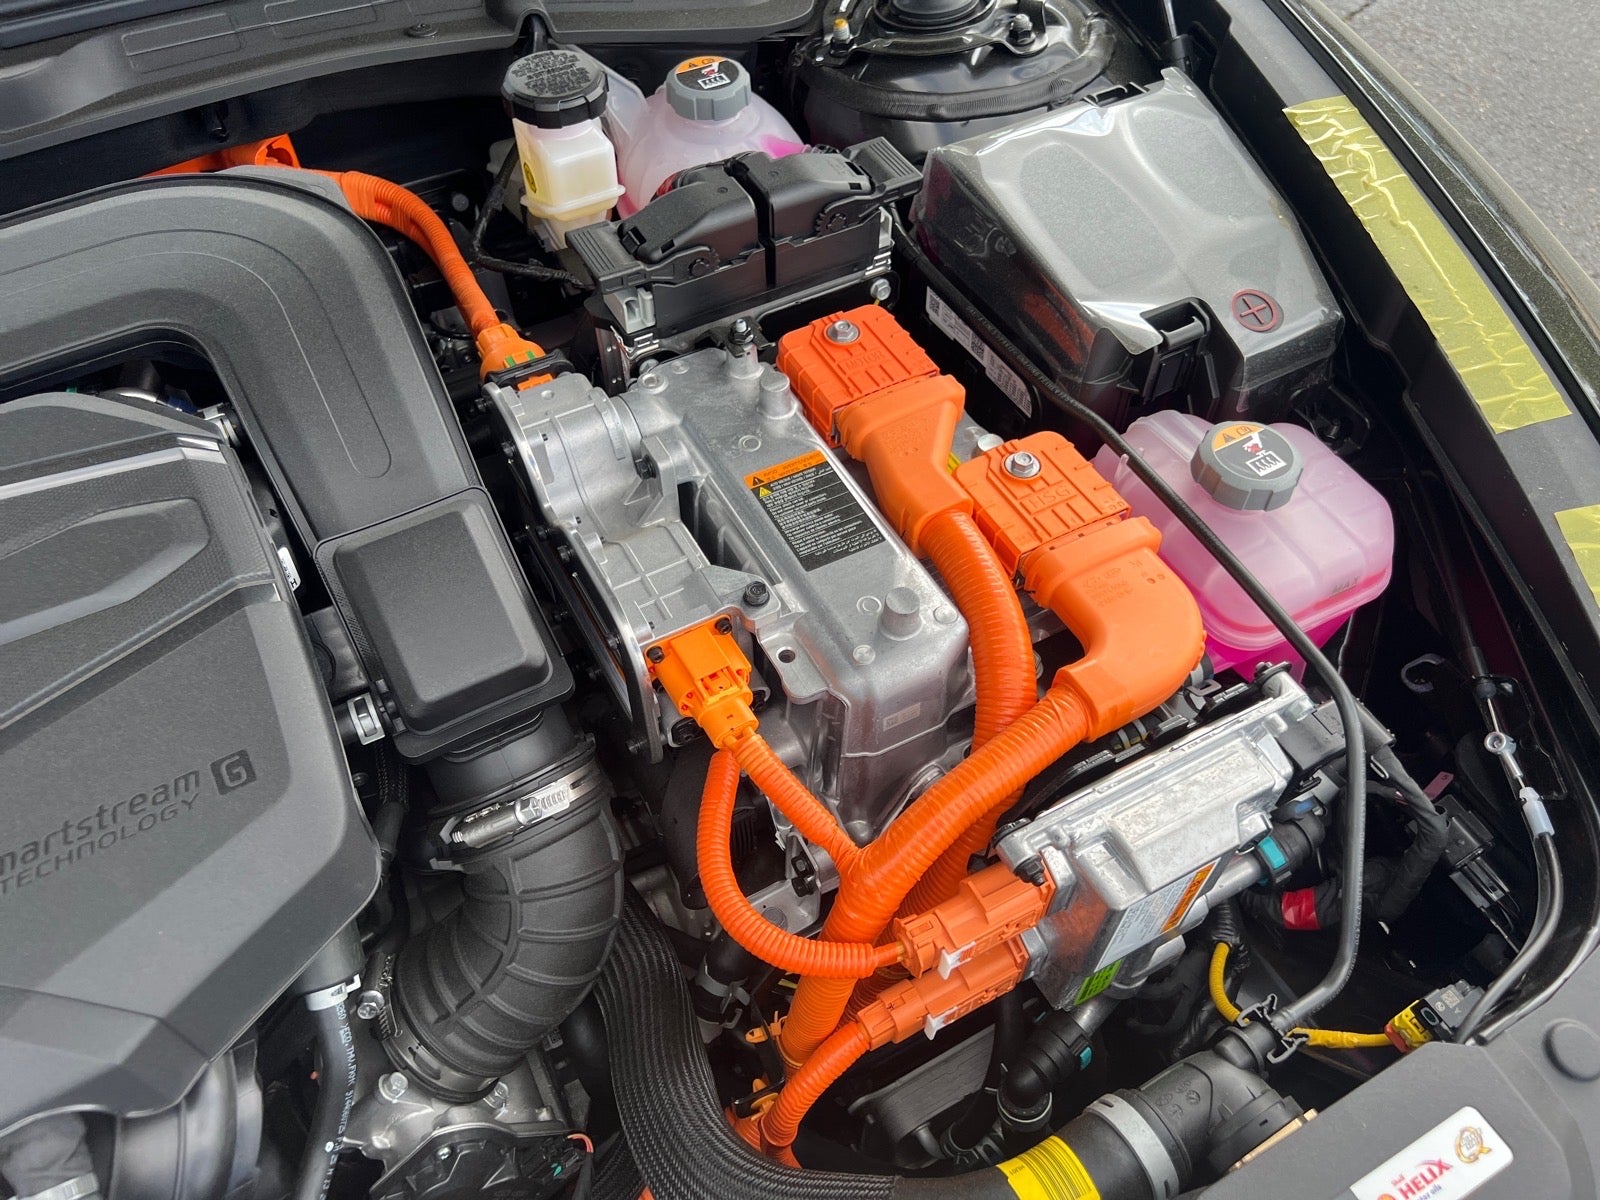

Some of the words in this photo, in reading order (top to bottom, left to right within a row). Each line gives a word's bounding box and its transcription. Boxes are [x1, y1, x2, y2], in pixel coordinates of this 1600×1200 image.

[1028, 484, 1072, 510] HSG
[217, 752, 250, 790] G
[1398, 1158, 1451, 1200] HELIX
